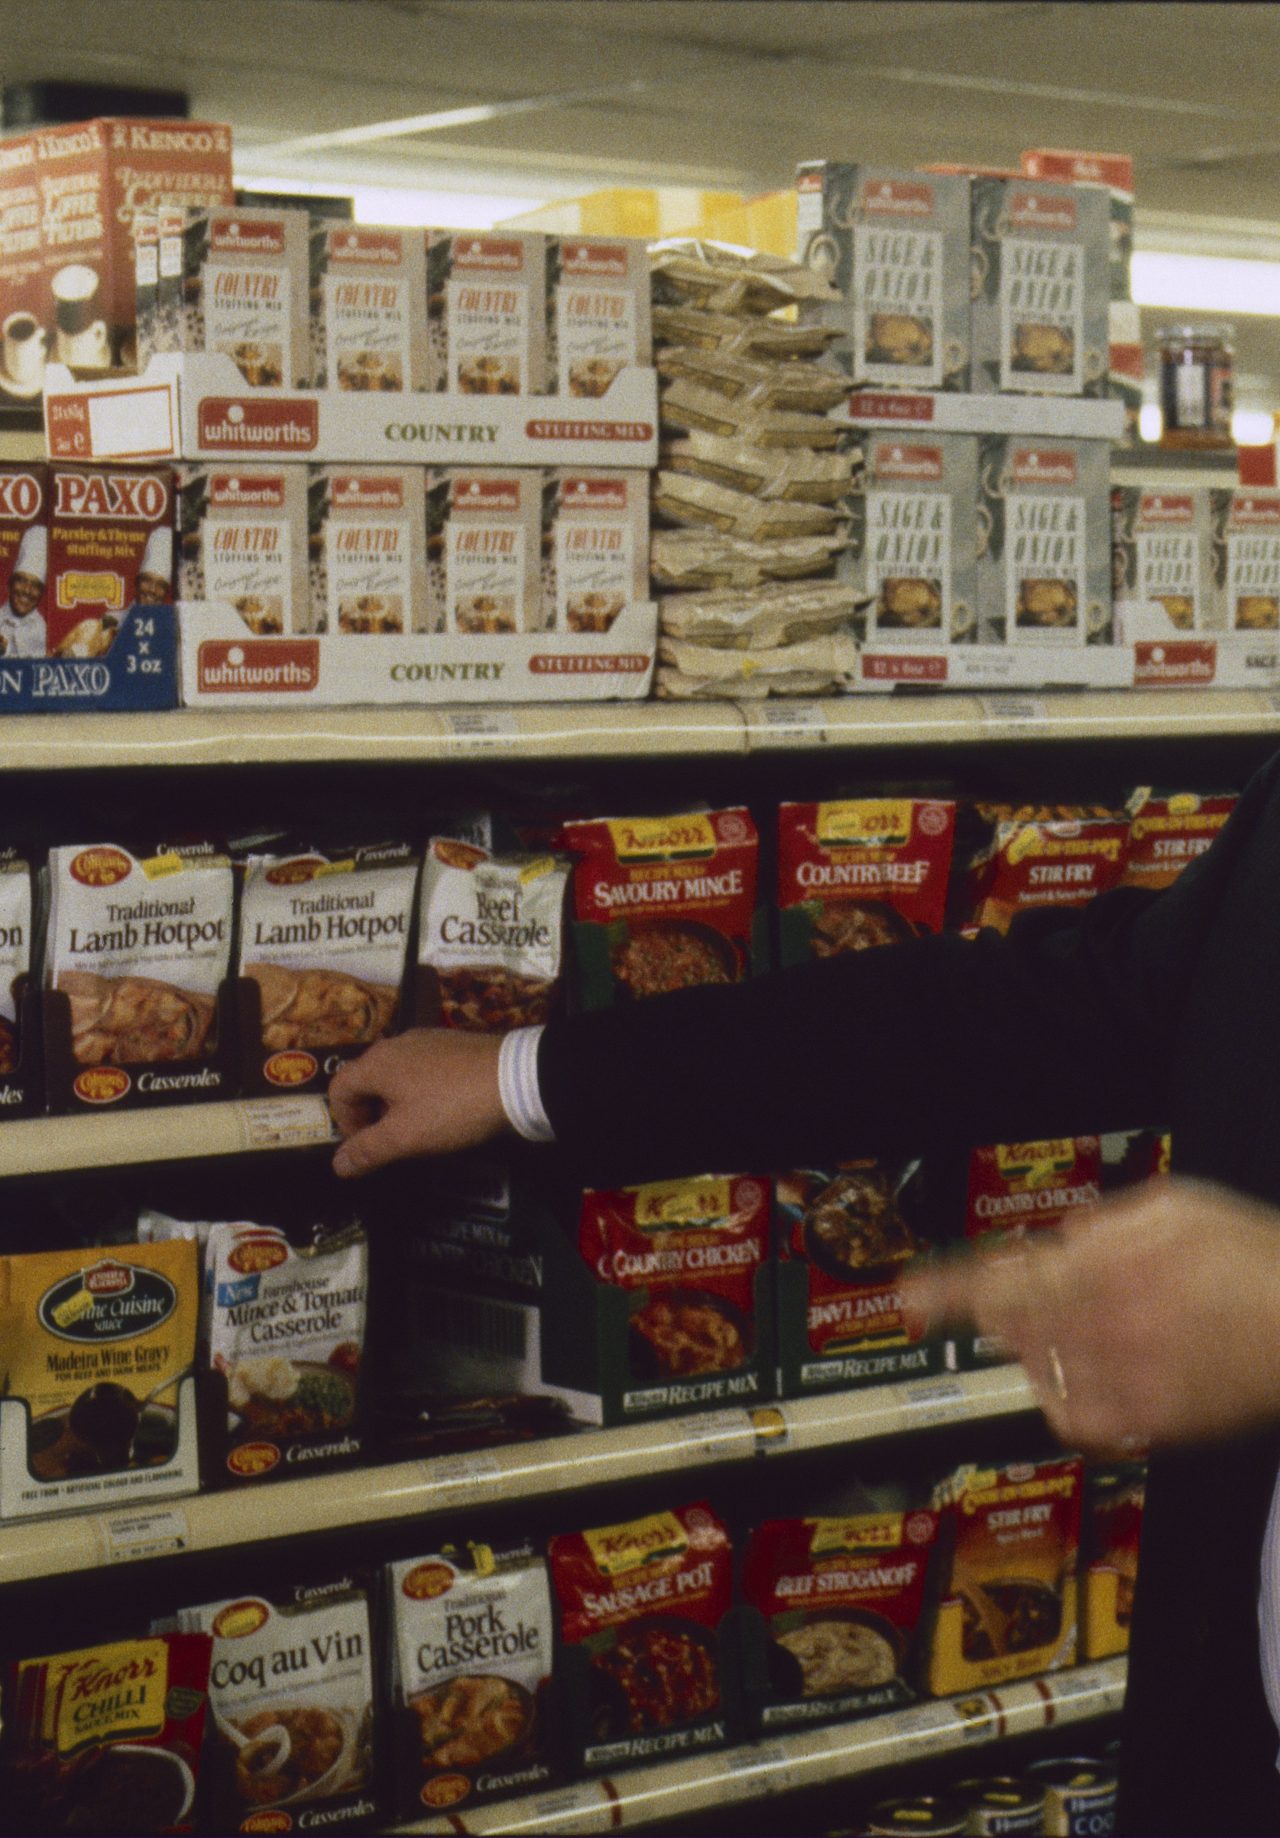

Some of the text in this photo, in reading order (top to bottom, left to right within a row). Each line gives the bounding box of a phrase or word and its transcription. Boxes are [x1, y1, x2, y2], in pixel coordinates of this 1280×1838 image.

[131, 126, 213, 151] KENCO
[205, 421, 312, 443] whitworths
[384, 423, 499, 443] COUNTRY
[535, 422, 647, 439] STUFFING MIX
[55, 473, 167, 521] PAXO
[879, 500, 942, 530] SAGE &
[1016, 501, 1076, 531] SAGE &
[53, 527, 98, 543] Parsley
[108, 529, 146, 543] Thyme
[877, 534, 941, 562] ONION
[1015, 534, 1076, 562] ONION
[67, 544, 136, 558] Stuffing Mix
[134, 618, 155, 637] 24
[138, 641, 149, 655] x
[1246, 655, 1278, 669] SAGE
[127, 656, 162, 673] 3 oz
[204, 660, 311, 685] whitworths
[390, 662, 505, 681] COUNTRY
[537, 655, 645, 670] STUFFING MIX
[1135, 653, 1212, 678] whitworths
[32, 663, 111, 697] PAXO
[355, 842, 412, 861] Casserole
[1153, 840, 1187, 857] STIR
[796, 860, 930, 888] COUNTRY BEEF
[1029, 864, 1095, 885] STIR FRY
[593, 878, 682, 909] SAVOURY
[684, 869, 744, 898] MINCE
[106, 898, 196, 922] Traditional
[290, 891, 375, 916] Traditional
[476, 890, 523, 923] Beef
[69, 919, 224, 954] Lamb Hotpot
[254, 913, 405, 945] Lamb Hotpot
[440, 915, 551, 947] Casserole
[137, 1069, 221, 1092] Casseroles
[975, 1192, 1036, 1218] COUNTRY
[613, 1238, 760, 1277] COUNTRY CHICKEN
[263, 1277, 330, 1299] Farmhouse
[109, 1294, 165, 1318] Cuisine
[226, 1303, 280, 1327] Mince
[282, 1296, 297, 1313] &
[250, 1309, 342, 1343] Casserole
[47, 1345, 170, 1373] Madeira Wine Gravy
[842, 1349, 928, 1379] RECIPE MIX
[668, 1372, 760, 1406] RECIPE MIX
[286, 1437, 360, 1463] Casseroles
[987, 1503, 1055, 1531] STIR FRY
[294, 1577, 353, 1601] Casserole
[582, 1560, 715, 1619] SAUSAGE POT
[816, 1561, 919, 1593] STROGANOFF
[446, 1605, 506, 1642] Pork
[211, 1655, 265, 1688] Coq
[272, 1645, 308, 1674] au
[311, 1632, 363, 1665] Vin
[417, 1621, 539, 1673] Casserole
[71, 1657, 158, 1700] Knorr
[74, 1685, 146, 1723] CHILLI
[630, 1720, 727, 1756] RECIPE MIX
[475, 1764, 549, 1792] Casseroles
[298, 1800, 375, 1829] Casseroles
